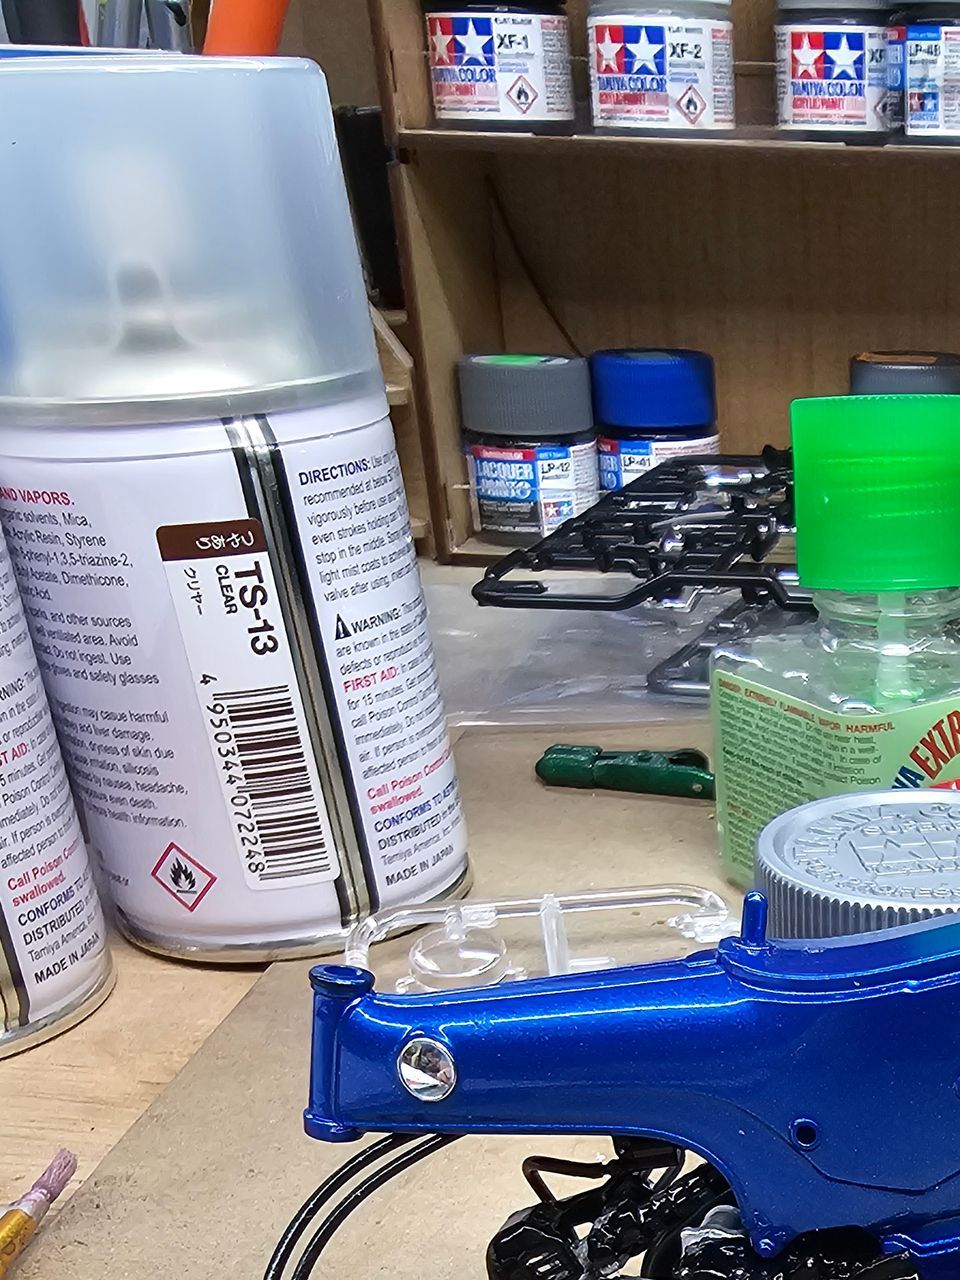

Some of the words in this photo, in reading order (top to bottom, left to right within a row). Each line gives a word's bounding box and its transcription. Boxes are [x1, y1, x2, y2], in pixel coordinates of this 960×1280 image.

[497, 34, 529, 50] XF-1
[669, 43, 703, 59] XF-2
[459, 67, 496, 83] COLOR
[629, 77, 667, 92] COLOR
[299, 457, 371, 485] DIRECTIONS:
[541, 461, 571, 475] LP-12
[18, 490, 75, 506] VAPORS.
[303, 480, 364, 506] recommended
[62, 512, 92, 528] Mica,
[307, 505, 354, 527] vigorously
[65, 533, 106, 549] Styrene
[311, 531, 336, 546] even
[337, 523, 367, 540] strokes
[316, 550, 337, 565] stop
[61, 571, 129, 587] Dimethicone,
[319, 568, 341, 586] light
[215, 564, 238, 614] CLEAR
[323, 586, 350, 602] valve
[235, 561, 280, 656] TS-13
[91, 616, 132, 627] sources
[351, 608, 402, 634] WARNING:
[109, 634, 139, 647] Avoid
[110, 653, 132, 666] Use
[336, 645, 351, 657] are
[339, 658, 373, 676] defects
[119, 671, 160, 686] glasses
[200, 674, 217, 685] 4
[343, 672, 377, 693] FIRST
[129, 710, 169, 723] harmful
[368, 706, 397, 724] Poison
[846, 722, 895, 734] HARMFUL
[154, 746, 174, 759] due
[206, 702, 243, 785] 950344
[367, 784, 390, 800] Call
[391, 771, 424, 791] Poison
[3, 786, 31, 805] Poison
[374, 800, 432, 833] CONFORMS
[231, 795, 266, 874] 072248
[378, 814, 441, 850] DISTRIBUTED
[1, 847, 36, 869] affected
[380, 847, 412, 867] Tamiya
[8, 872, 31, 891] Call
[32, 856, 64, 882] Poison
[385, 864, 418, 886] MADE
[419, 859, 430, 872] IN
[18, 886, 75, 926] CONFORMS
[23, 899, 86, 946] DISTRIBUTED
[27, 938, 60, 962] Tamiya
[34, 958, 68, 984] MADE
[69, 954, 79, 967] IN
